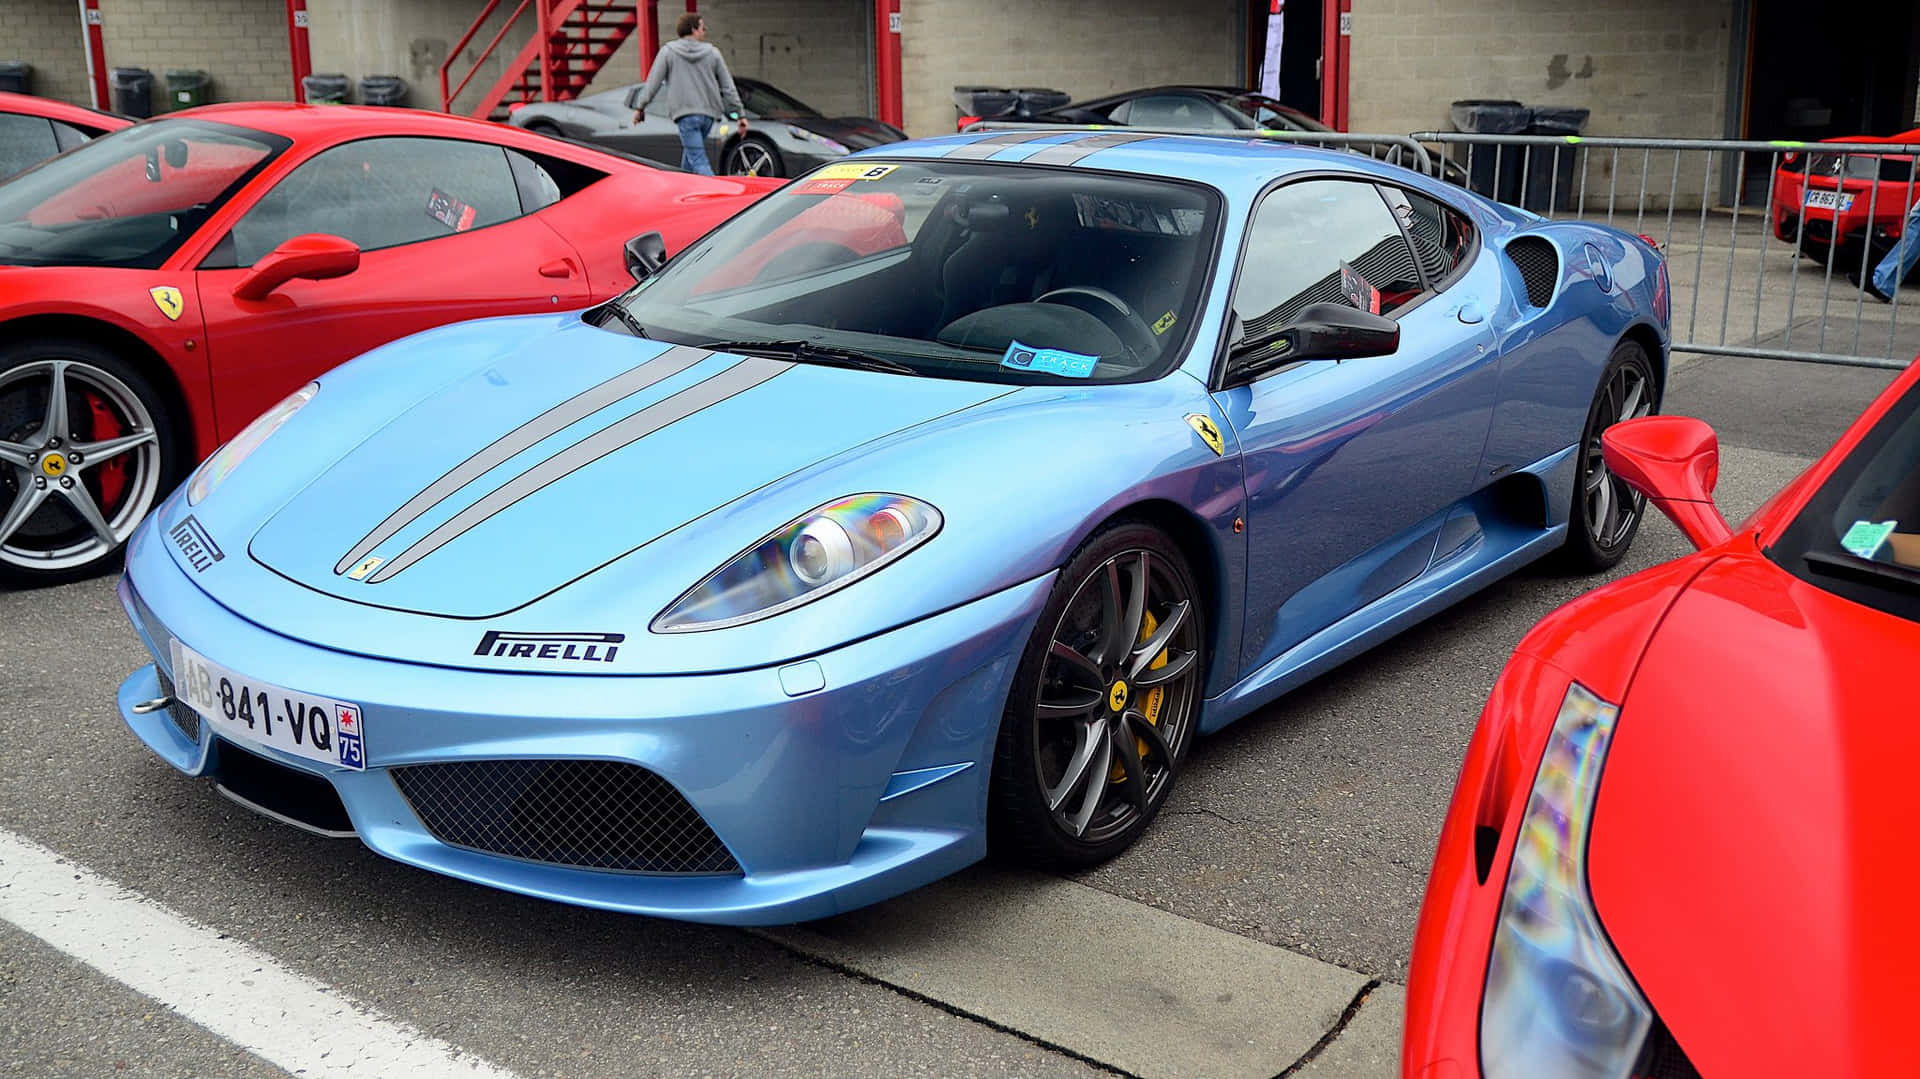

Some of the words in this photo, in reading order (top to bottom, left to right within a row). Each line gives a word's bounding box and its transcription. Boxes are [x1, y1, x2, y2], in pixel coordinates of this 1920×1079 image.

[169, 514, 226, 573] PIRELLI
[473, 630, 626, 663] PIRELLI
[339, 736, 361, 763] 75
